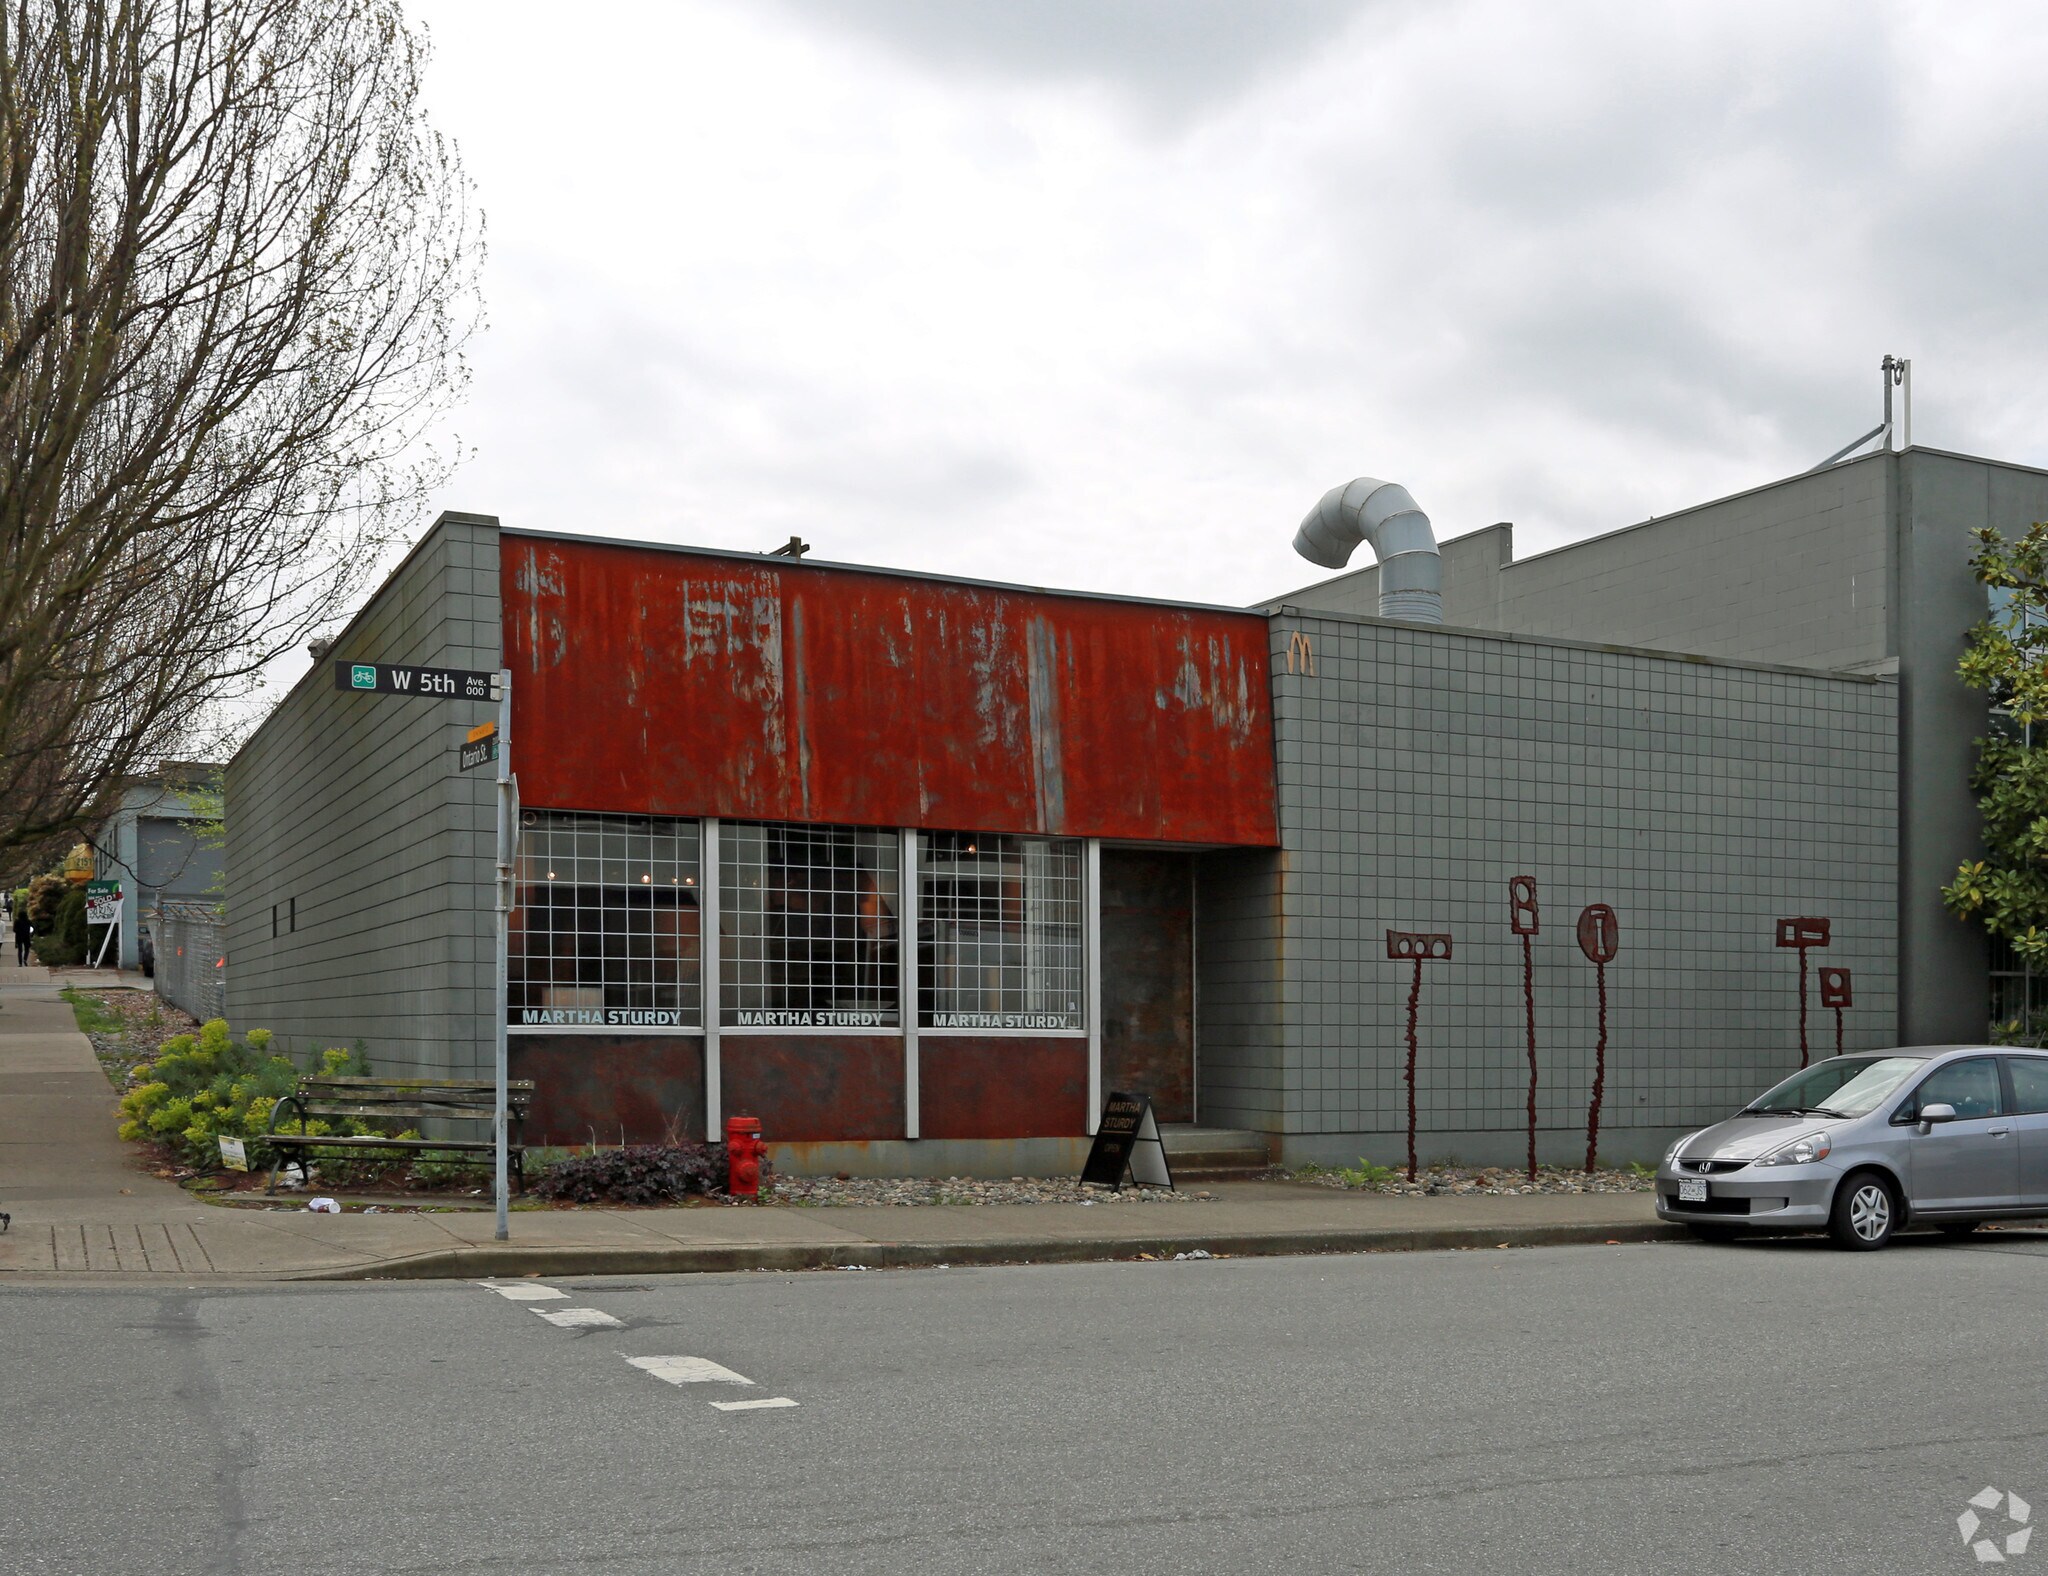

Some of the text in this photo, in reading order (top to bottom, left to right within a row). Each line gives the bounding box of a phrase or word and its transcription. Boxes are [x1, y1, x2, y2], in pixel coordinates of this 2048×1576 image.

[391, 670, 487, 693] W 5th Ave.
[466, 687, 485, 696] 000
[463, 746, 480, 768] Ontario
[522, 1010, 681, 1025] MARTHA STURDY
[738, 1011, 884, 1026] MARTHA STURDY
[933, 1013, 1068, 1028] MARTHA STURDY
[1108, 1101, 1141, 1113] MARTHA
[1104, 1117, 1137, 1129] STURDY
